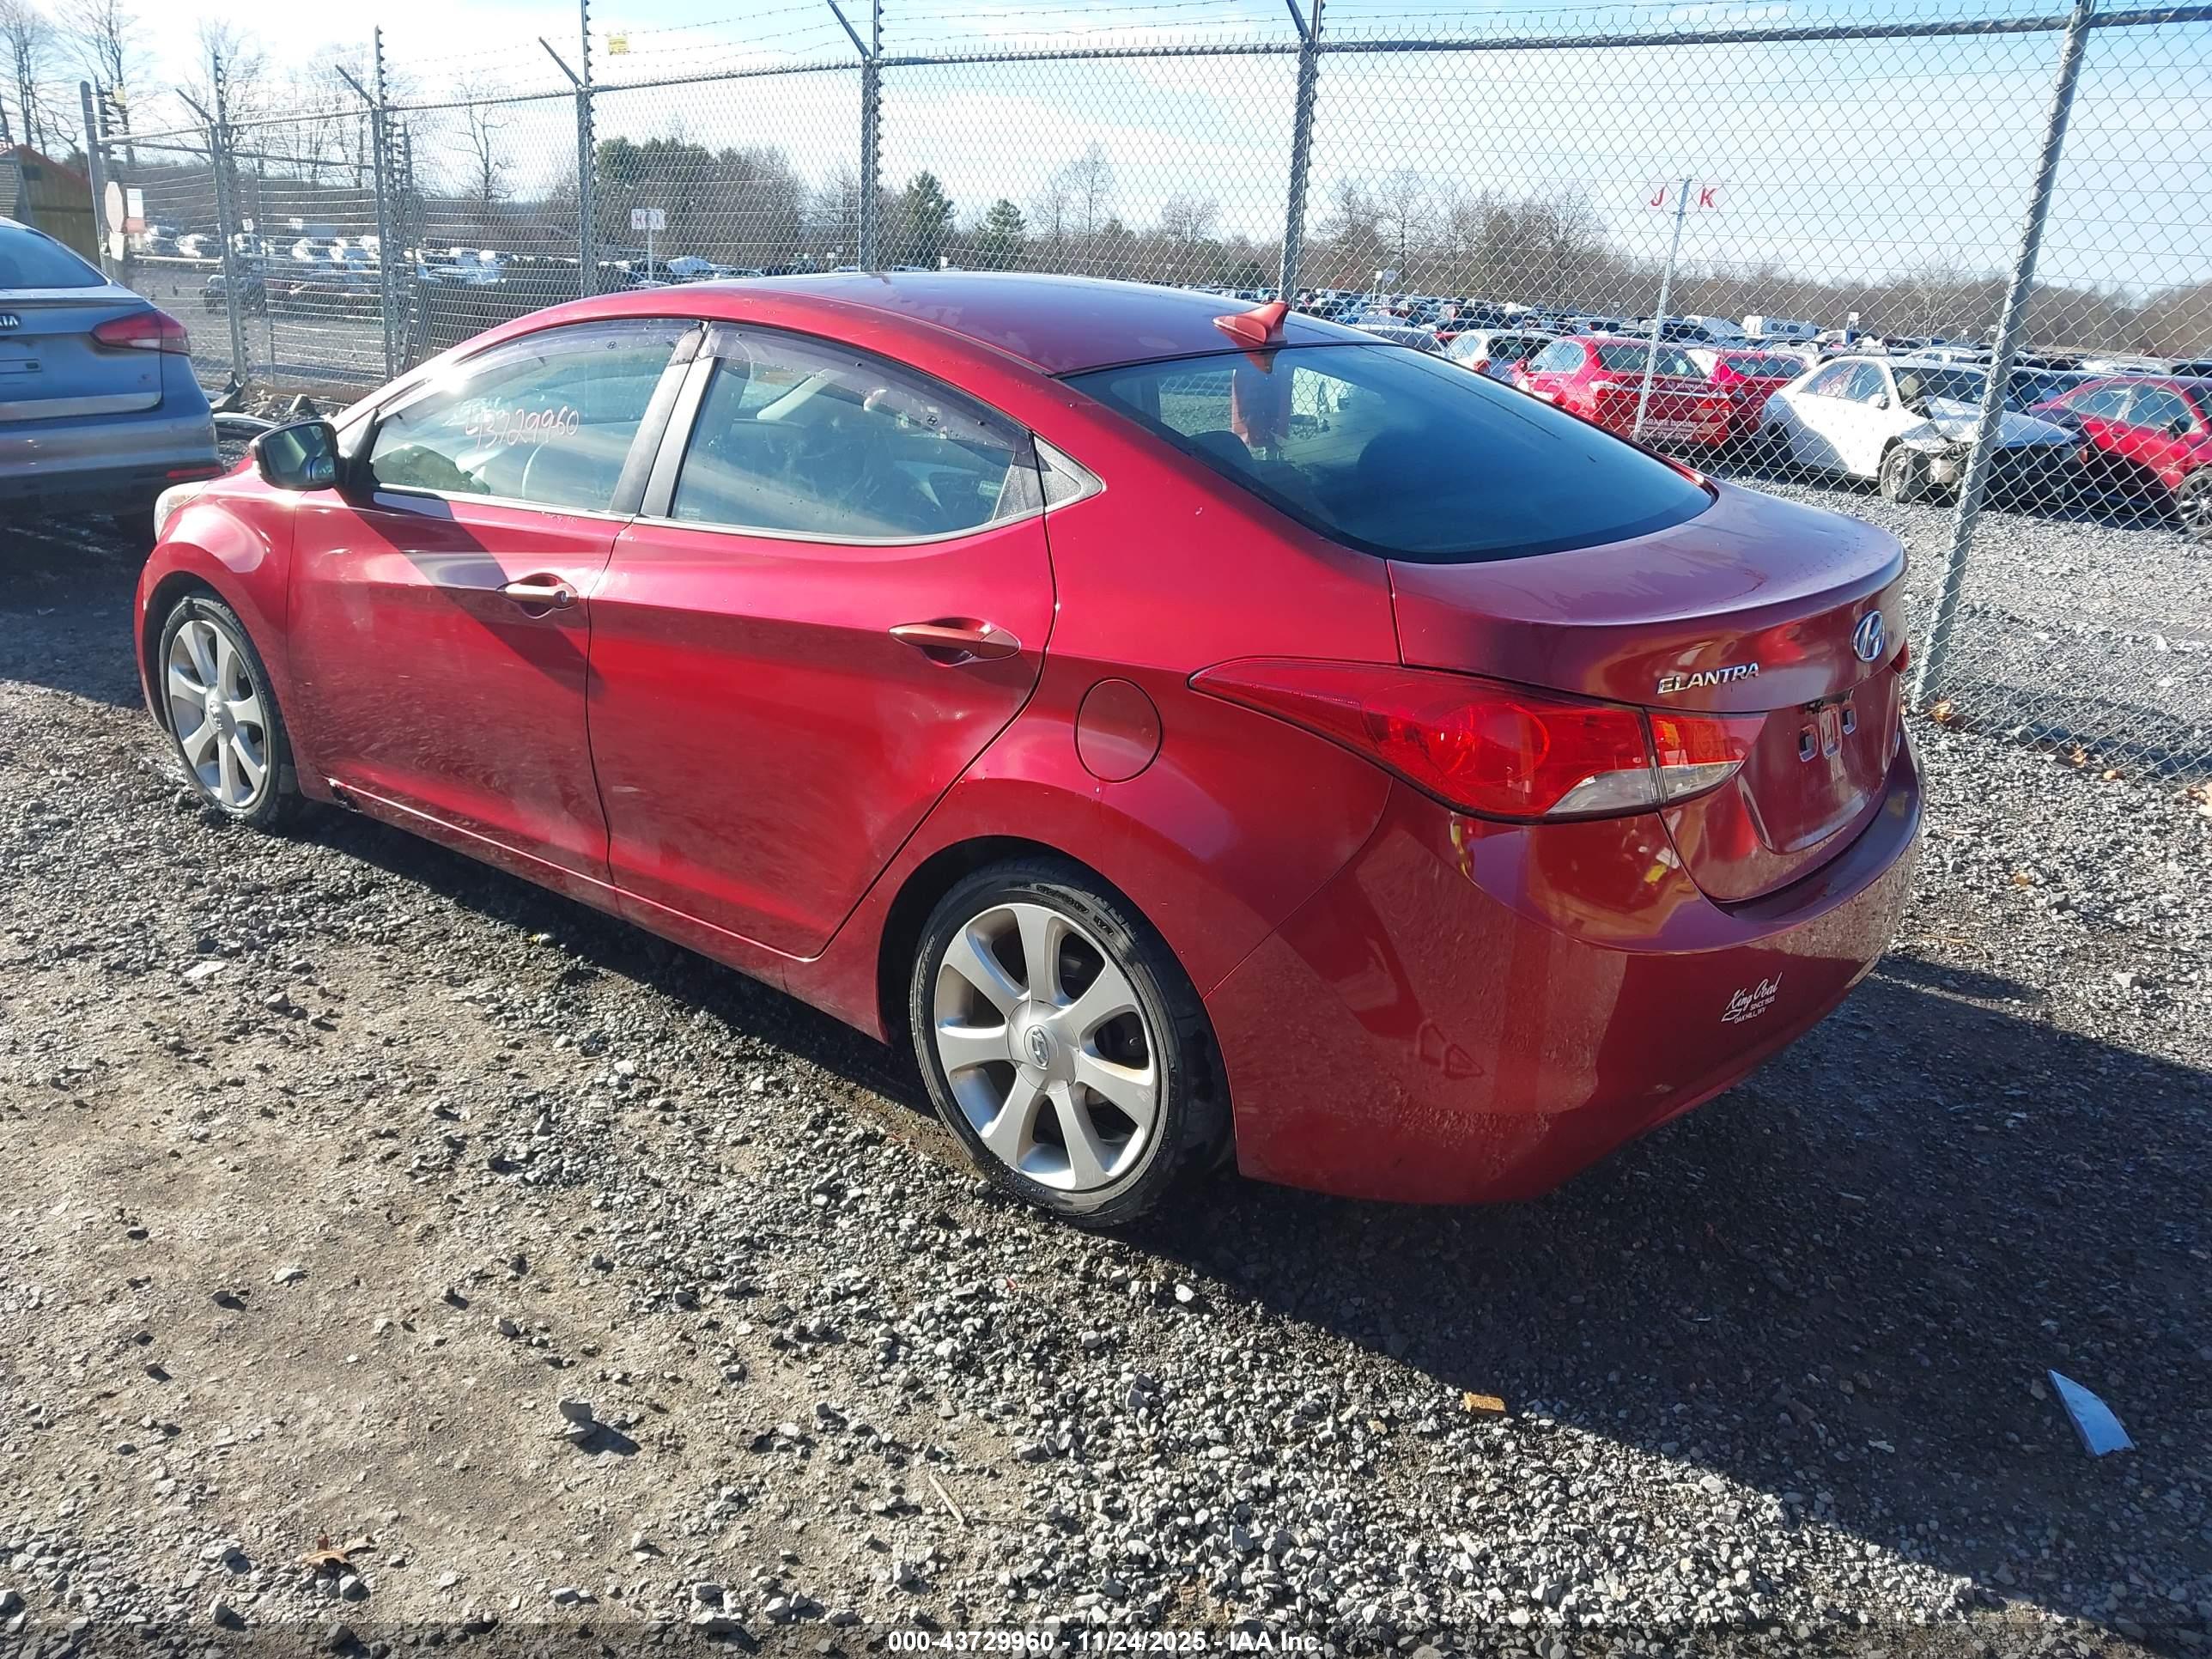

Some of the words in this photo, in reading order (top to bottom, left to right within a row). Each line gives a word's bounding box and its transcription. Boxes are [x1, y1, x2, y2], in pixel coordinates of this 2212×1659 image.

[1650, 185, 1666, 207] J
[1699, 186, 1717, 209] K
[465, 404, 580, 449] 43729960
[1656, 661, 1759, 695] ELANTRA
[1725, 988, 1753, 1012] King
